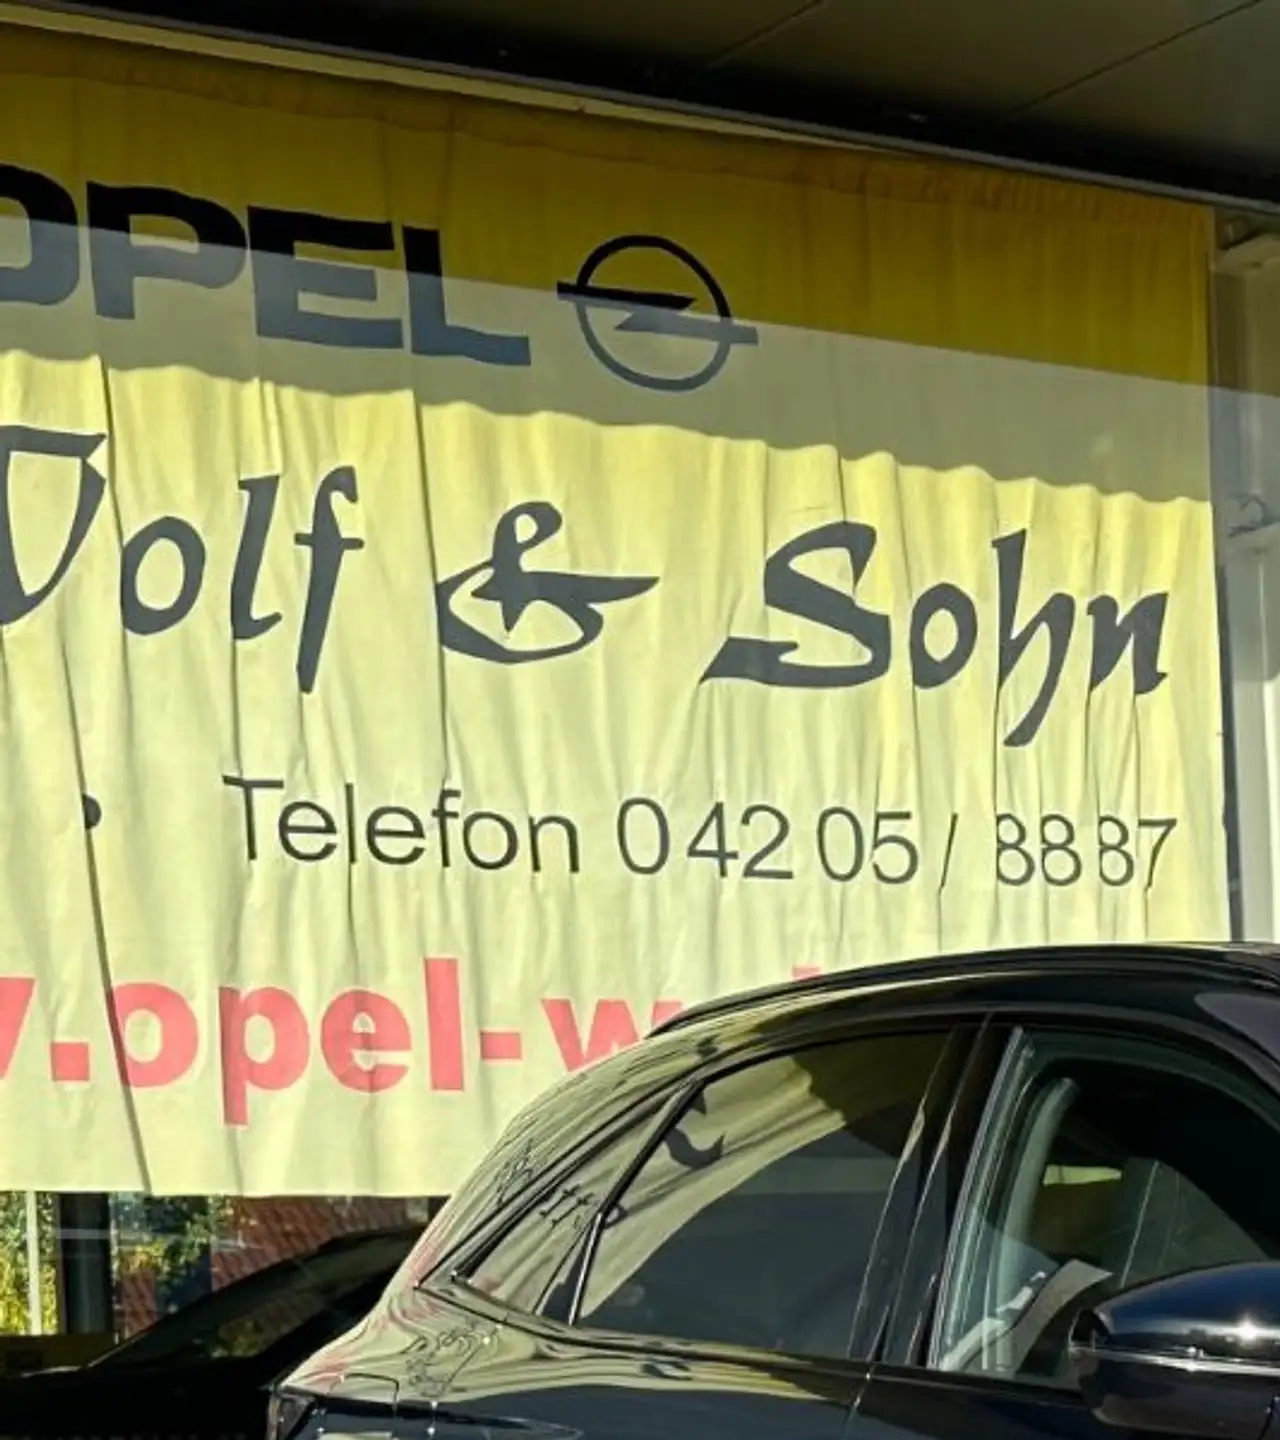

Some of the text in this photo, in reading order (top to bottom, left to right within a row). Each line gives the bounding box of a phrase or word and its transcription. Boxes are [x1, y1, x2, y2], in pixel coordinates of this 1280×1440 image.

[435, 501, 660, 665] &
[700, 520, 1168, 748] Sohn
[222, 774, 579, 873] Telefon
